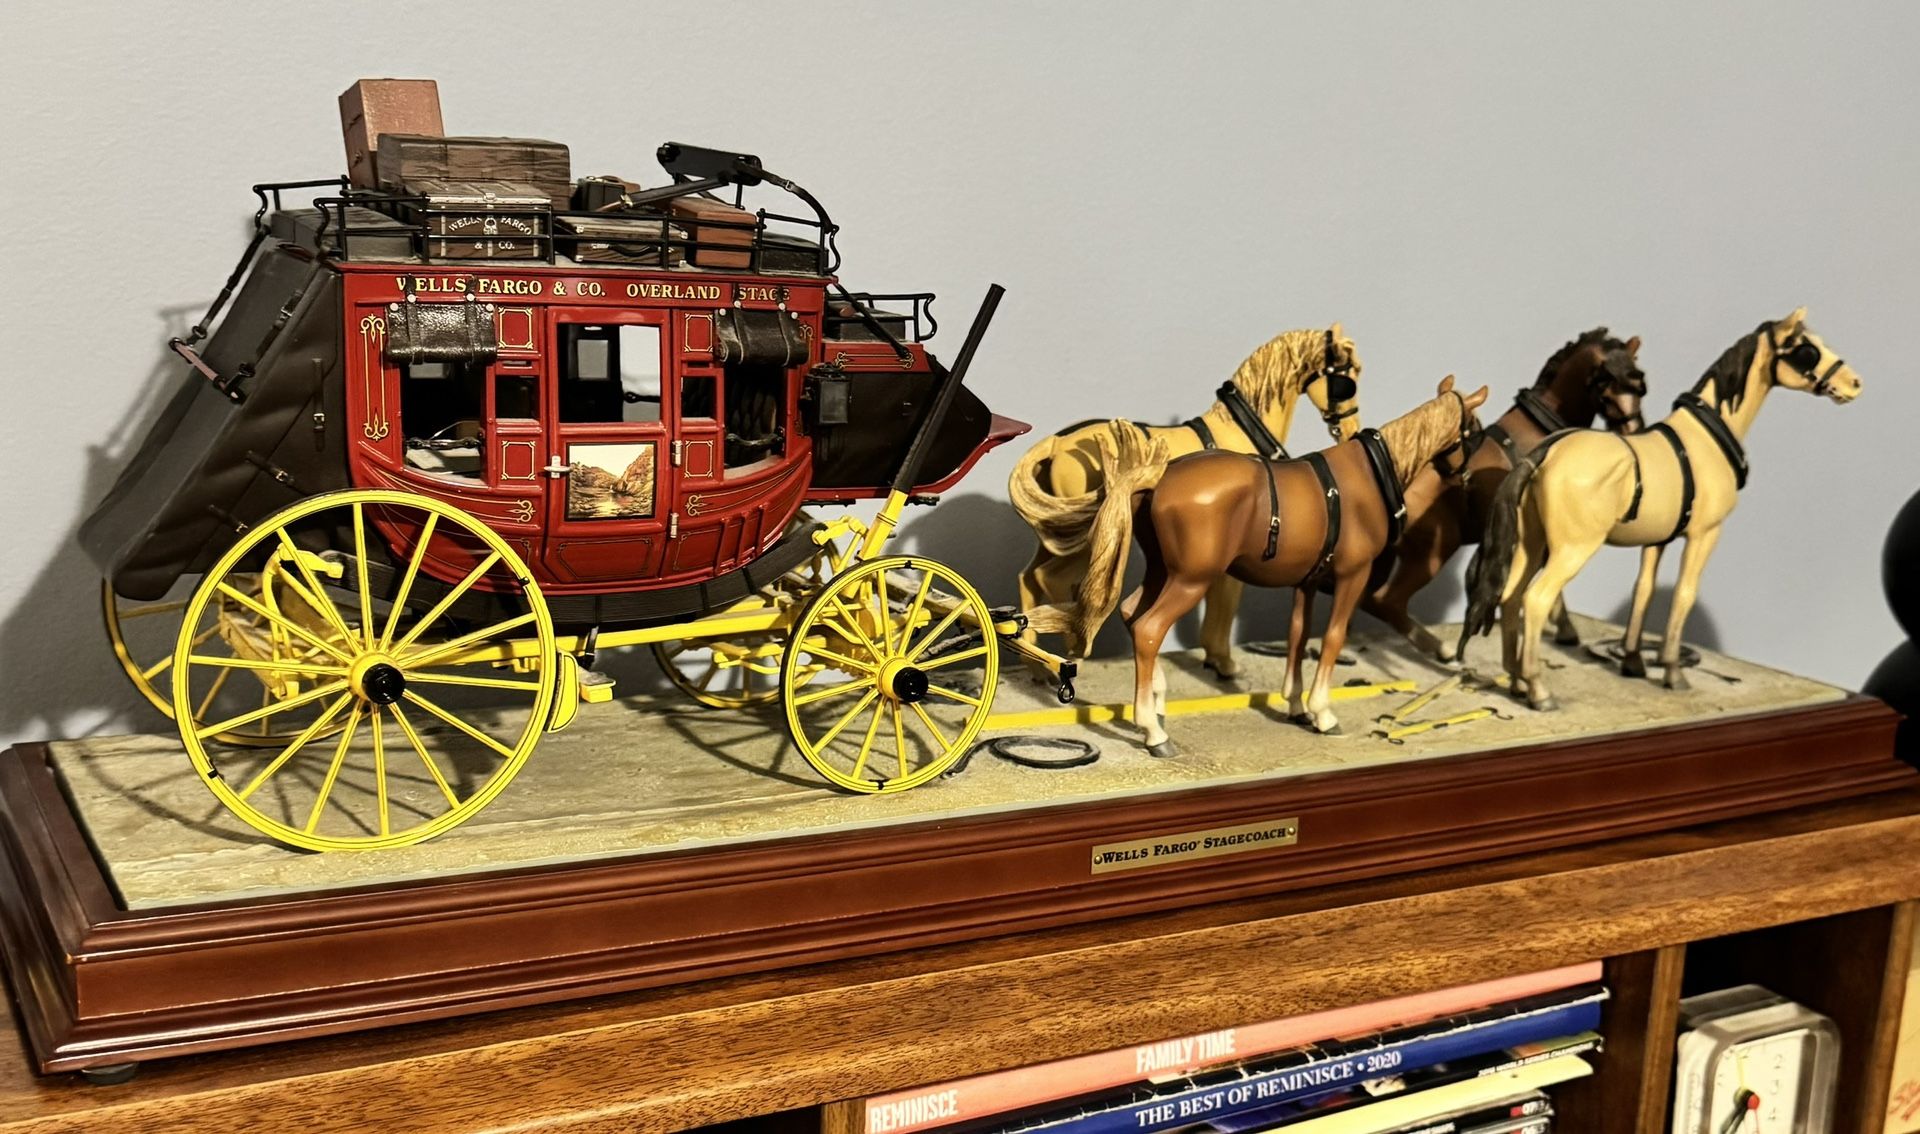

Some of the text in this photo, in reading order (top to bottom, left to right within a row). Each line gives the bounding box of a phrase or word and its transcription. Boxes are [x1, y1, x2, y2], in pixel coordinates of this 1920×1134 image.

[500, 217, 532, 235] FARGO
[474, 241, 515, 250] & CO.
[478, 278, 542, 295] FARGO
[553, 281, 567, 296] &
[576, 282, 606, 297] CO.
[626, 283, 721, 299] OVERLAND
[1102, 848, 1149, 863] WELLS
[1203, 828, 1286, 849] STAGECOACH
[1136, 1029, 1236, 1073] FAMILY TIME
[1136, 1051, 1402, 1127] THE BEST OF REMINISCE 2020
[870, 1089, 958, 1133] REMINISCE
